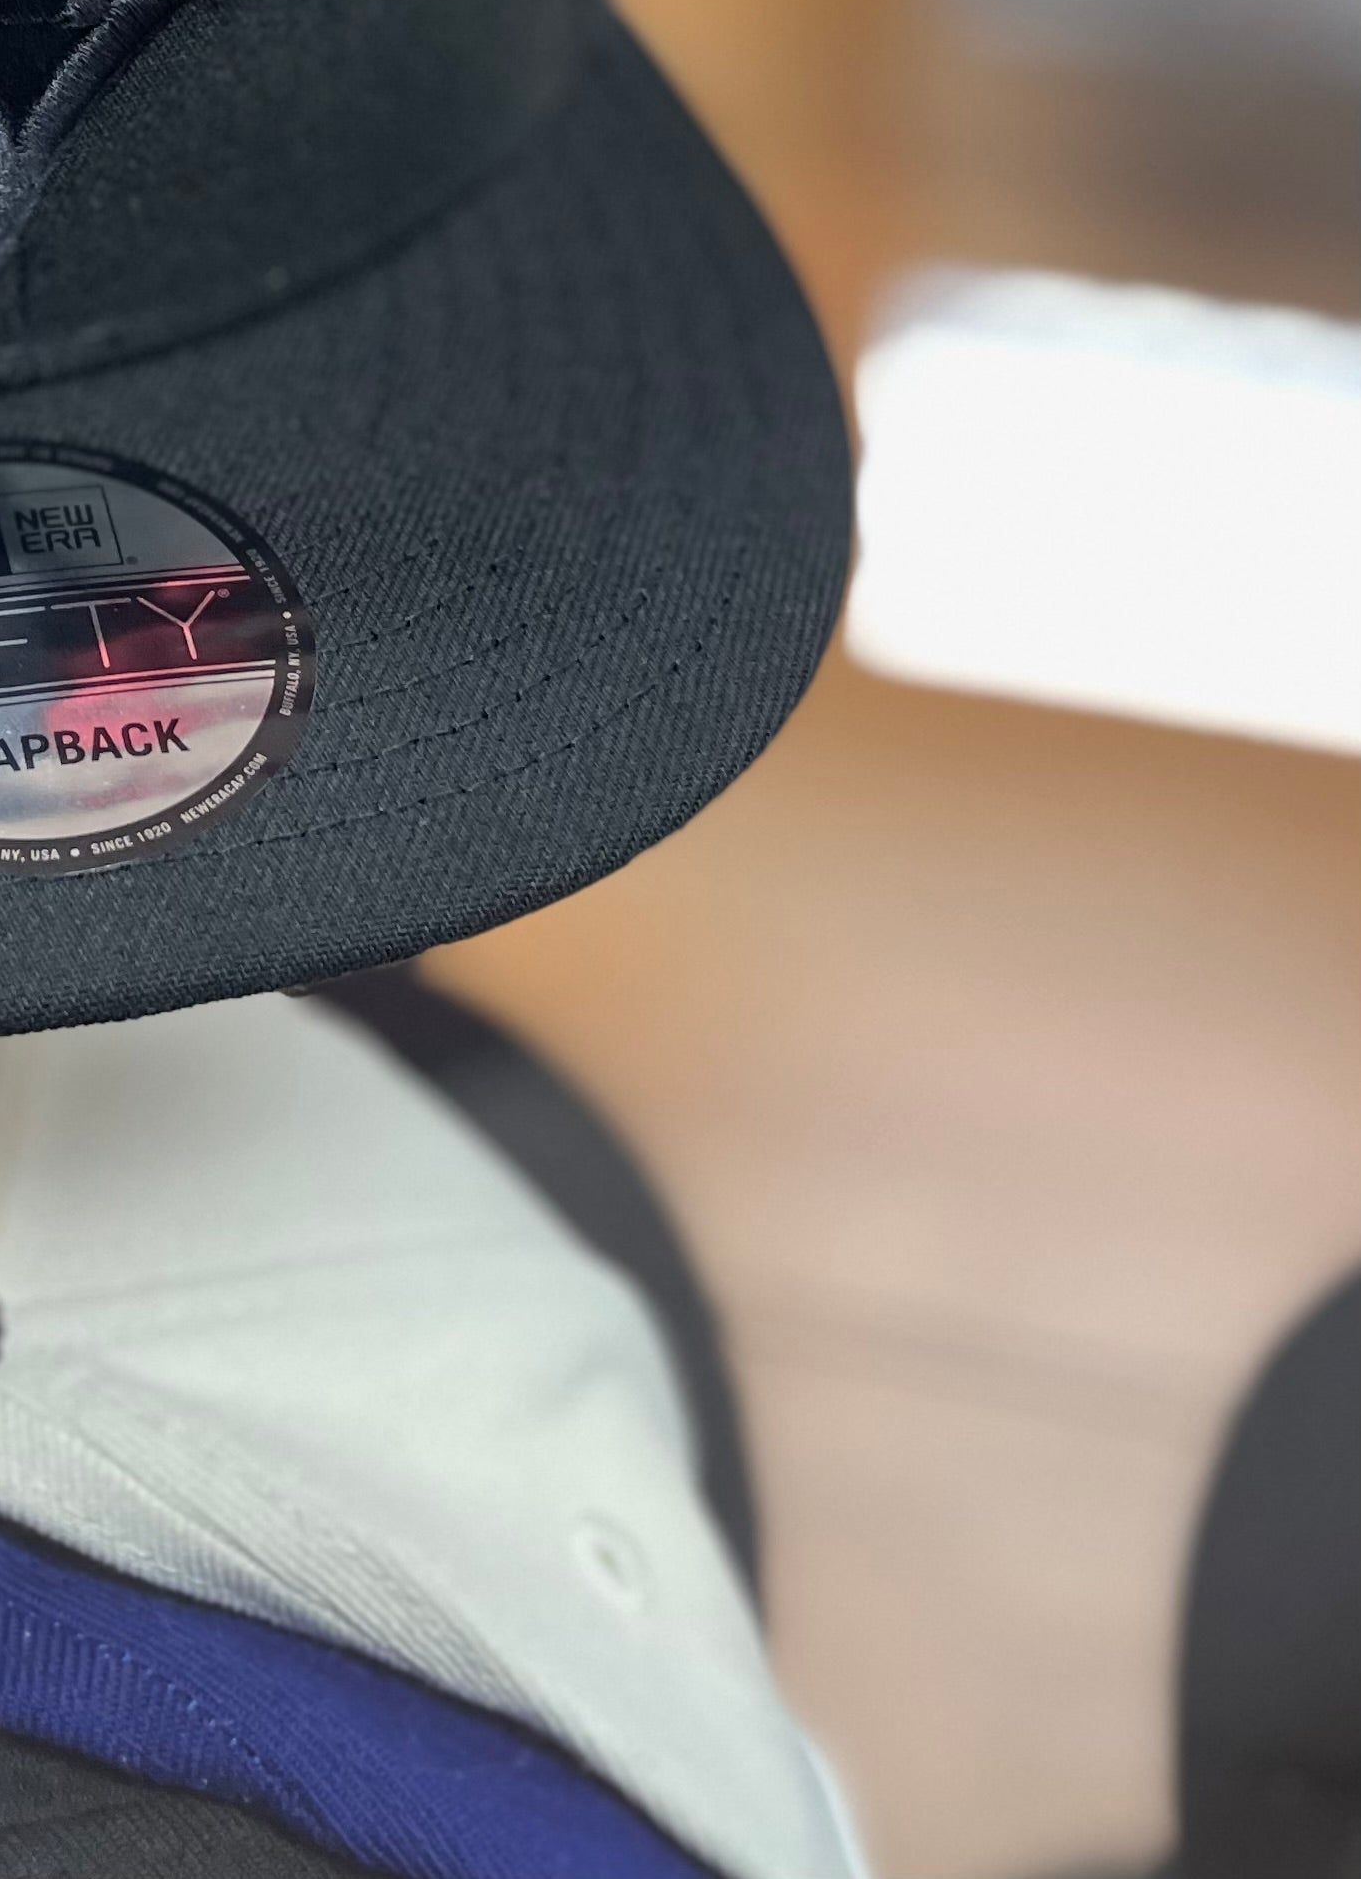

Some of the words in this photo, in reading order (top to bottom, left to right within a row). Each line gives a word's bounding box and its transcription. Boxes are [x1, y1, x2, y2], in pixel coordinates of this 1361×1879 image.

[14, 504, 94, 531] NEW
[20, 527, 101, 554] ERA
[284, 625, 298, 646] USA
[1, 848, 26, 864] NY,
[30, 848, 61, 862] USA
[91, 835, 134, 855] SINCE
[137, 821, 172, 843] 1920
[180, 752, 268, 824] NEWERACAP.COM
